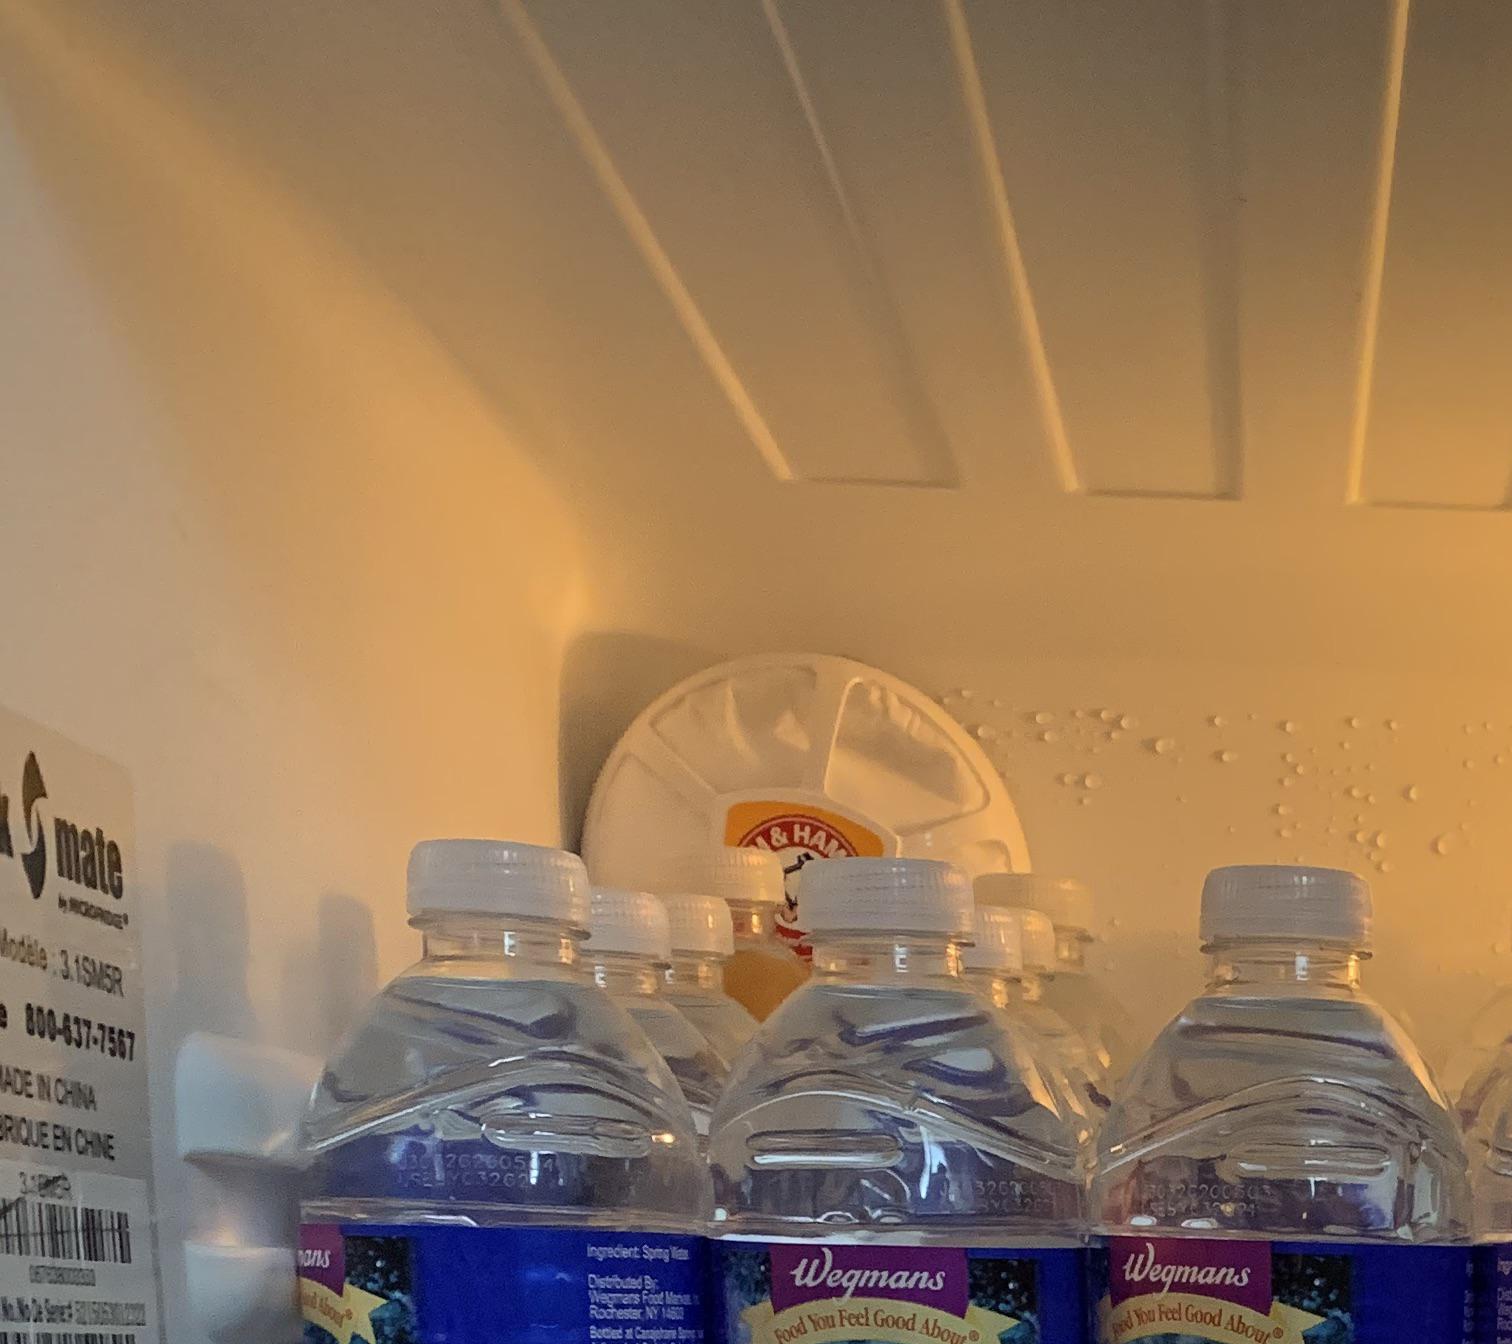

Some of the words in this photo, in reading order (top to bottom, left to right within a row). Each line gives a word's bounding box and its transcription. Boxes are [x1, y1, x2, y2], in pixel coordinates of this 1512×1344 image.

[54, 816, 124, 900] mate
[790, 1248, 946, 1303] Wegmans
[1122, 1242, 1251, 1294] Wegmans
[807, 1312, 836, 1333] You
[838, 1306, 870, 1329] Feel
[873, 1308, 917, 1333] Good
[1157, 1303, 1183, 1323] Feel
[1184, 1304, 1224, 1328] Good
